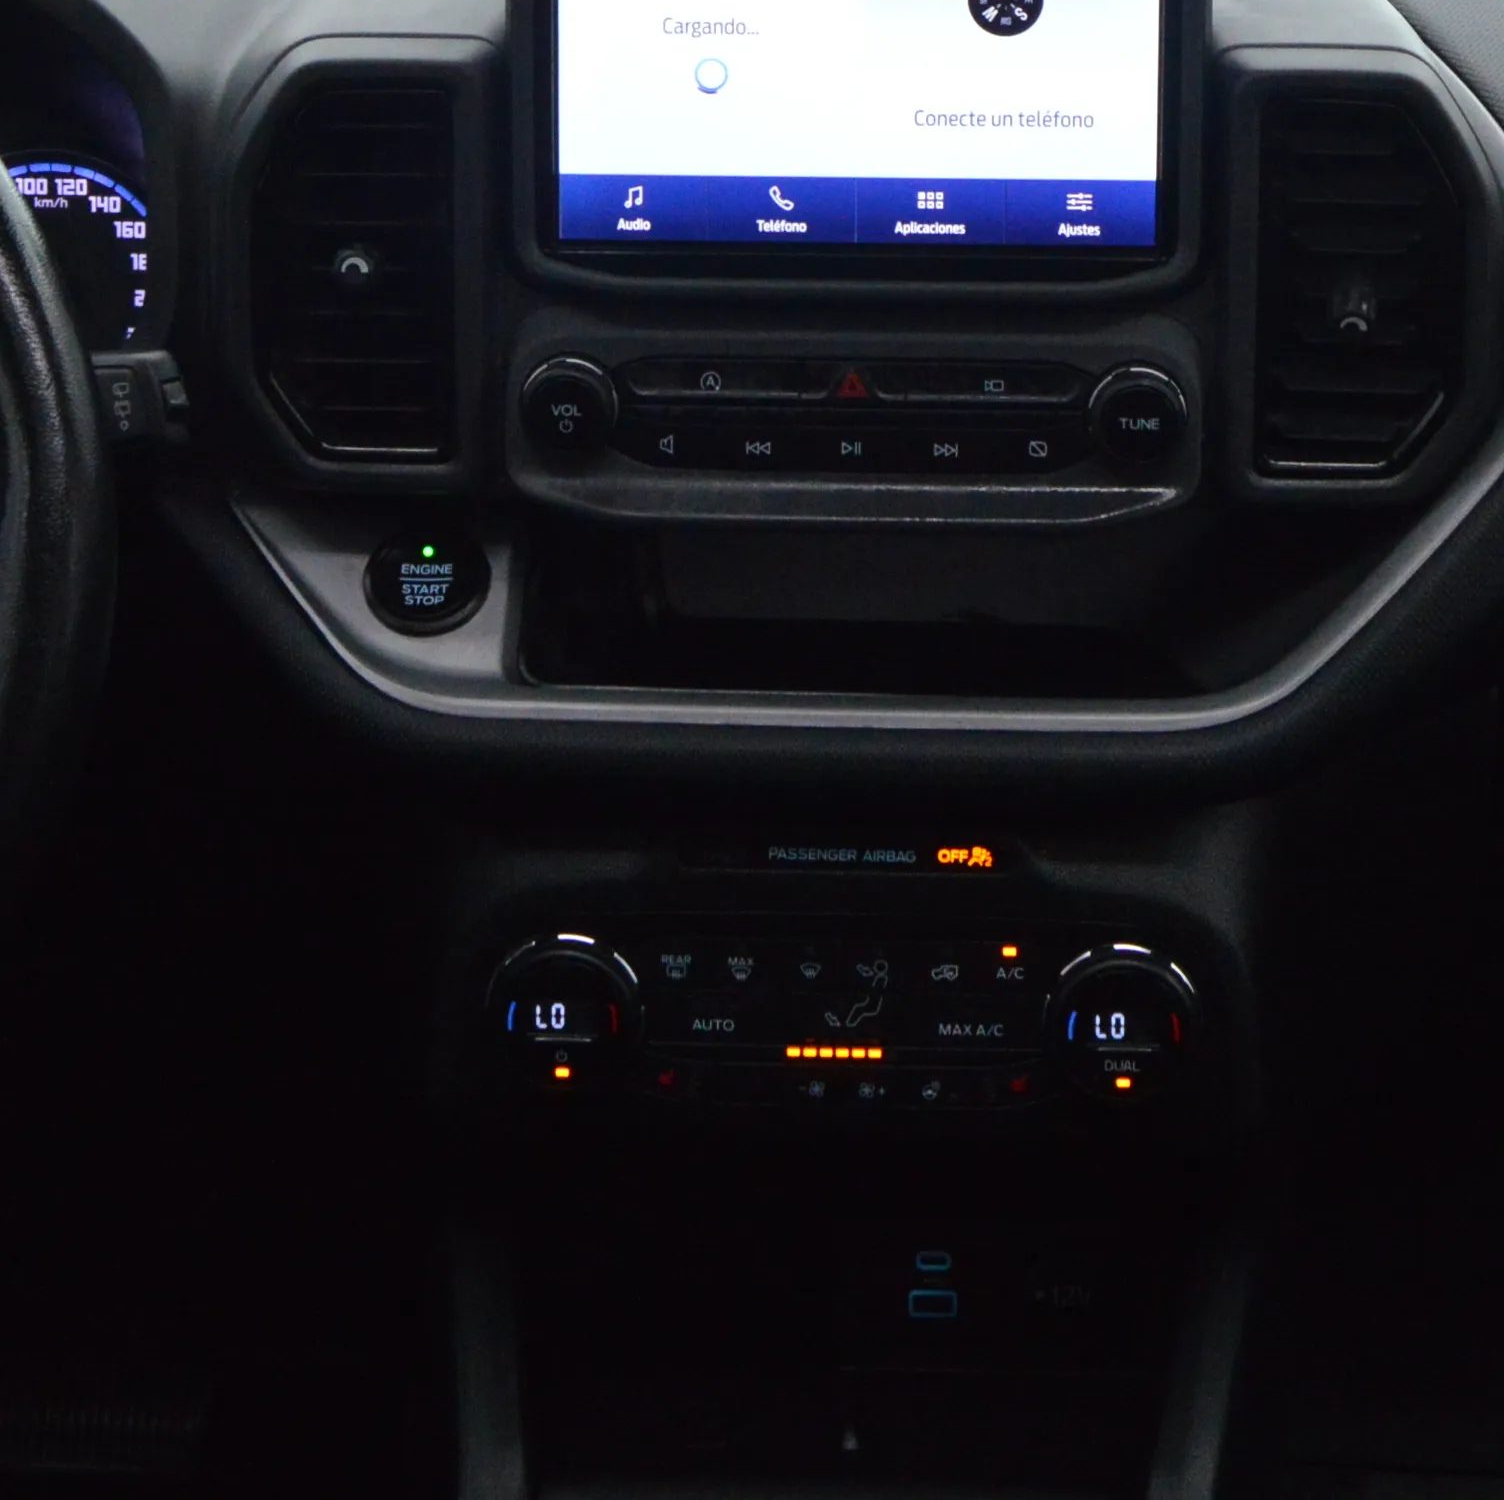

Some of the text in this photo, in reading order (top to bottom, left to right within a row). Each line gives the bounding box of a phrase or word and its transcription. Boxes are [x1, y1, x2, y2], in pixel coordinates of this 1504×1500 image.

[1014, 7, 1028, 22] S
[662, 17, 760, 38] Cargando...
[914, 109, 1094, 128] Conecte un teléfono
[15, 178, 48, 195] 100
[54, 178, 87, 196] 120
[34, 197, 68, 208] km/h
[88, 196, 121, 213] 140
[113, 221, 146, 239] 160
[617, 217, 651, 231] Audio
[756, 219, 807, 233] Teléfono
[894, 221, 966, 236] Aplicaciones
[1058, 223, 1101, 237] Ajustes
[551, 404, 582, 416] VOL
[1119, 417, 1160, 430] TUNE
[401, 563, 453, 575] ENGINE
[401, 584, 450, 594] START
[404, 595, 445, 606] STOP
[768, 847, 969, 864] PASSENGER AIRBAG OFF
[661, 954, 692, 964] REAR
[728, 956, 754, 966] MAX
[996, 967, 1025, 980] A/C
[692, 1018, 735, 1032] AUTO
[938, 1023, 1004, 1037] MAX A/C
[1104, 1058, 1140, 1072] DUAL
